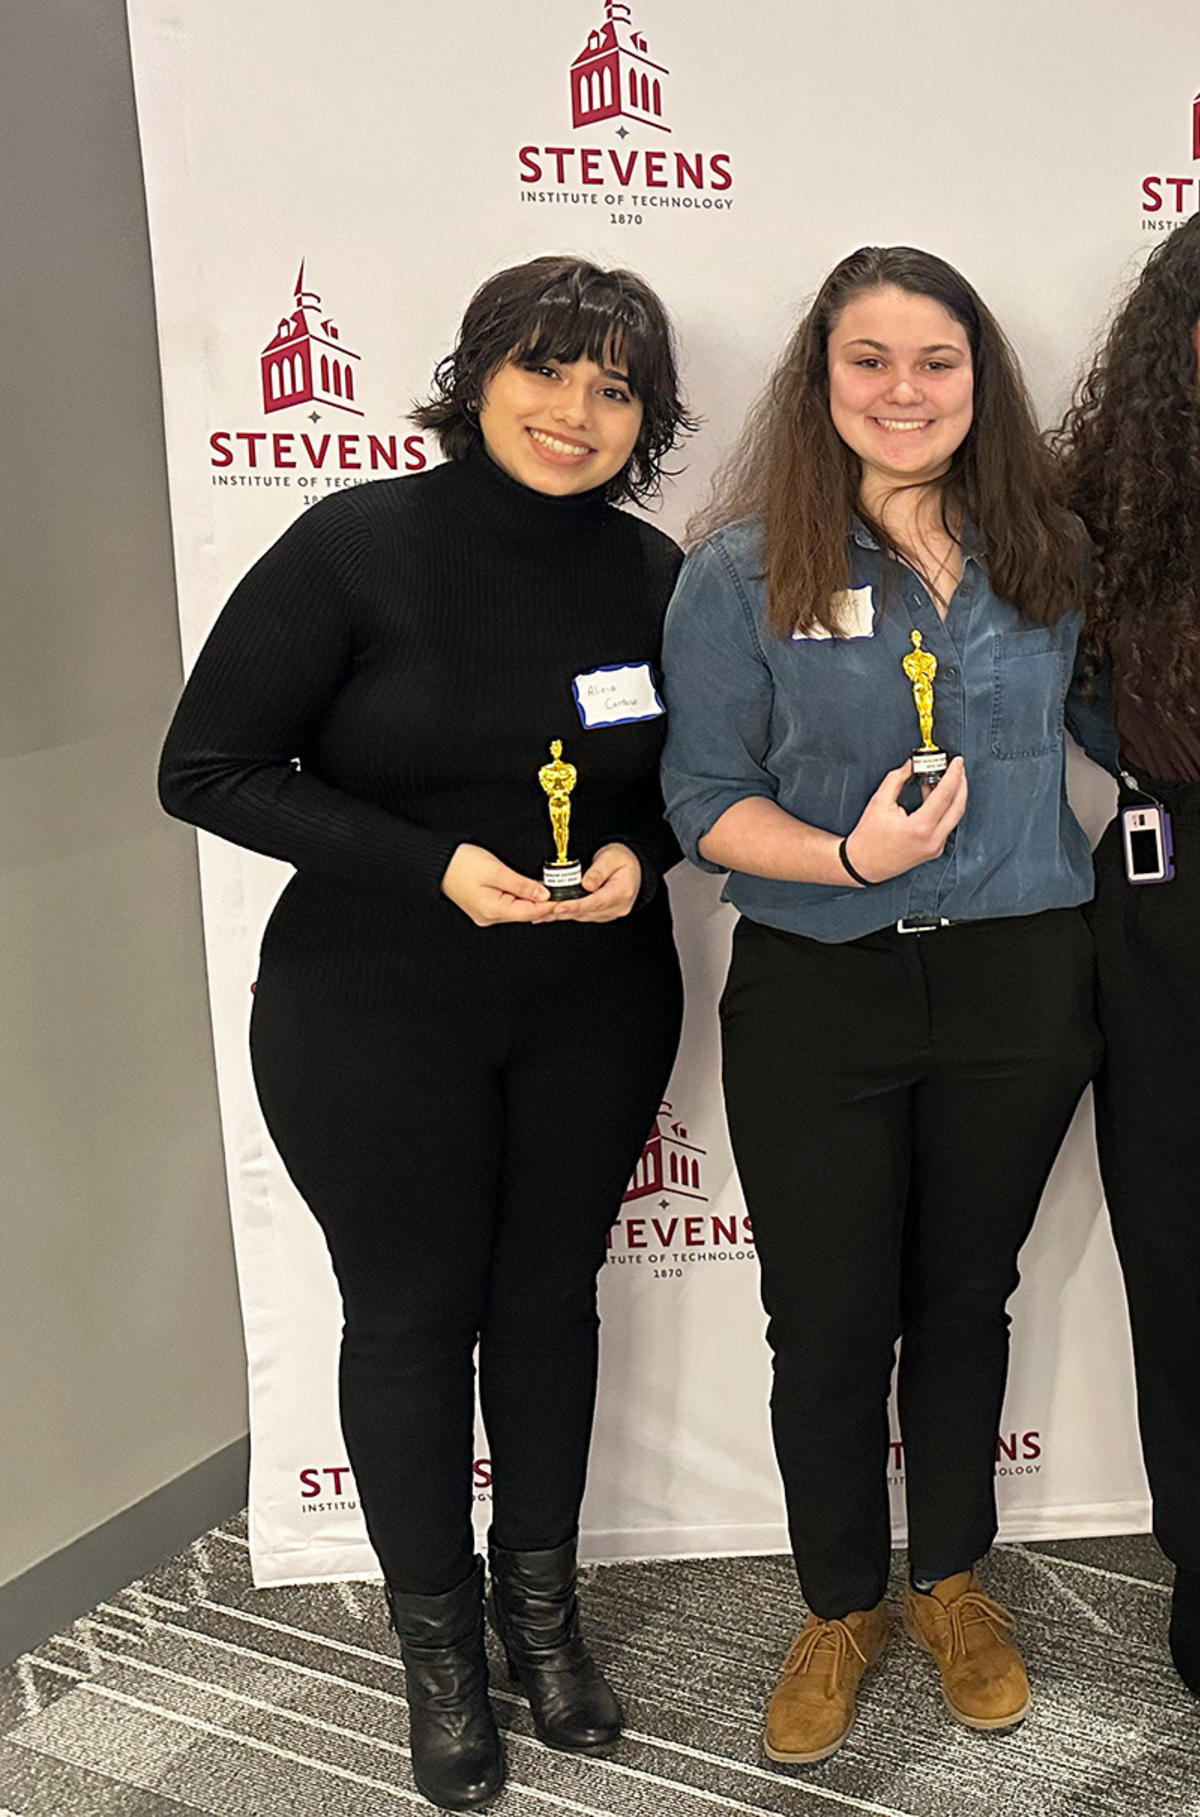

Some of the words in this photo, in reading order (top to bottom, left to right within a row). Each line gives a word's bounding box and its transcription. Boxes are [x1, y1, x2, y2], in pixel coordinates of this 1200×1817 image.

[519, 146, 733, 190] STEVENS
[521, 191, 598, 205] INSTITUTE
[604, 194, 624, 205] OF
[632, 195, 734, 210] TECHNOLOGY
[610, 213, 642, 225] 1870
[209, 432, 427, 470] STEVENS
[212, 475, 291, 487] INSTITUTE
[297, 476, 318, 487] OF
[648, 1254, 666, 1263] OF
[672, 1250, 755, 1263] TECHNOLOG
[653, 1268, 683, 1278] 1870
[302, 1501, 356, 1513] INSTITU
